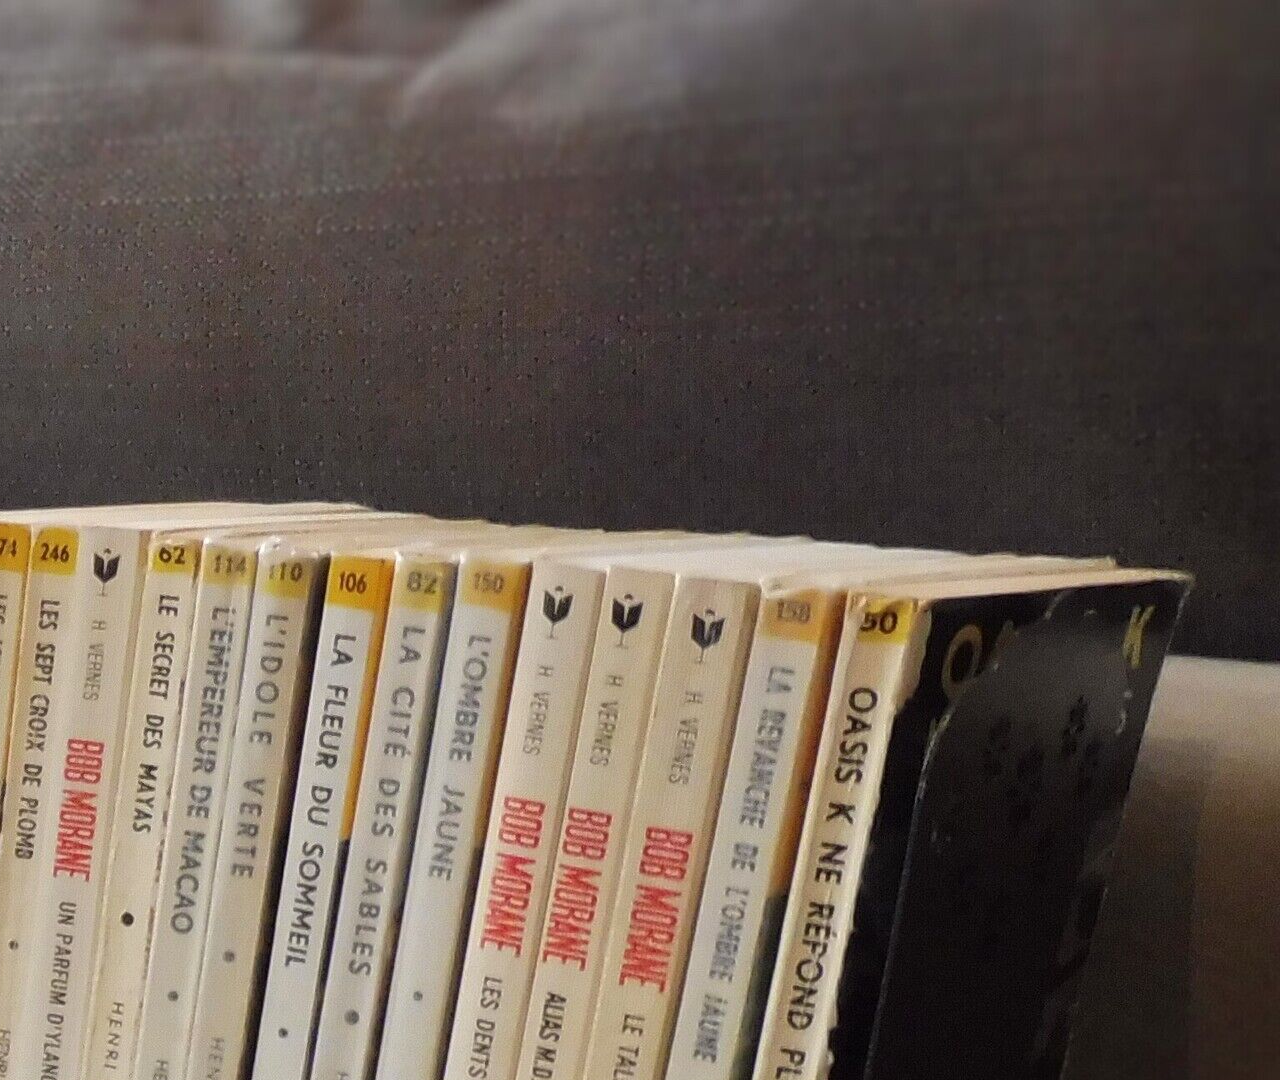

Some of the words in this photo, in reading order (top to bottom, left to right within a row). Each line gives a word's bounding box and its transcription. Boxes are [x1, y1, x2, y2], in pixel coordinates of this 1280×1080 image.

[39, 541, 70, 564] 246
[158, 544, 187, 566] 62
[156, 594, 181, 618] LE
[338, 570, 368, 595] 106
[405, 571, 438, 595] 82
[38, 599, 61, 631] LES
[398, 624, 427, 665] LA
[33, 642, 57, 686] SEPT
[148, 631, 176, 701] SECRET
[330, 631, 358, 668] LA
[192, 605, 238, 774] L'EMPEREUR
[248, 612, 290, 747] L'IDOLE
[449, 633, 493, 763] L'OMBRE
[24, 693, 51, 752] CROIX
[142, 714, 165, 751] DES
[313, 682, 350, 771] FLEUR
[383, 685, 416, 759] CITÉ
[832, 686, 879, 786] OASIS
[21, 762, 43, 790] DE
[63, 737, 106, 786] BOB
[740, 710, 789, 831] REVANCHE
[132, 762, 159, 834] MAYAS
[186, 784, 214, 821] DE
[305, 783, 334, 828] DU
[370, 776, 402, 839] DES
[497, 795, 546, 851] BOB
[824, 801, 857, 824] K
[13, 796, 39, 860] PLOMB
[51, 788, 99, 882] MORANE
[230, 777, 267, 880] VERTE
[427, 784, 466, 882] JAUNE
[561, 806, 614, 864] BOB
[638, 824, 694, 883] BOB
[169, 831, 206, 935] MACAO
[729, 840, 759, 876] DE
[812, 841, 849, 887] NE
[57, 900, 78, 927] UN
[284, 839, 326, 968] SOMMEIL
[348, 857, 389, 977] SABLES
[479, 851, 538, 959] MORANE
[541, 863, 604, 973] MORANE
[617, 882, 684, 995] MORANE
[49, 932, 76, 1008] PARFUM
[480, 975, 503, 1011] LES
[98, 1001, 125, 1072] HENRI
[539, 989, 569, 1042] ALIAS
[621, 1011, 646, 1039] LE
[466, 1017, 496, 1080] DENTS
